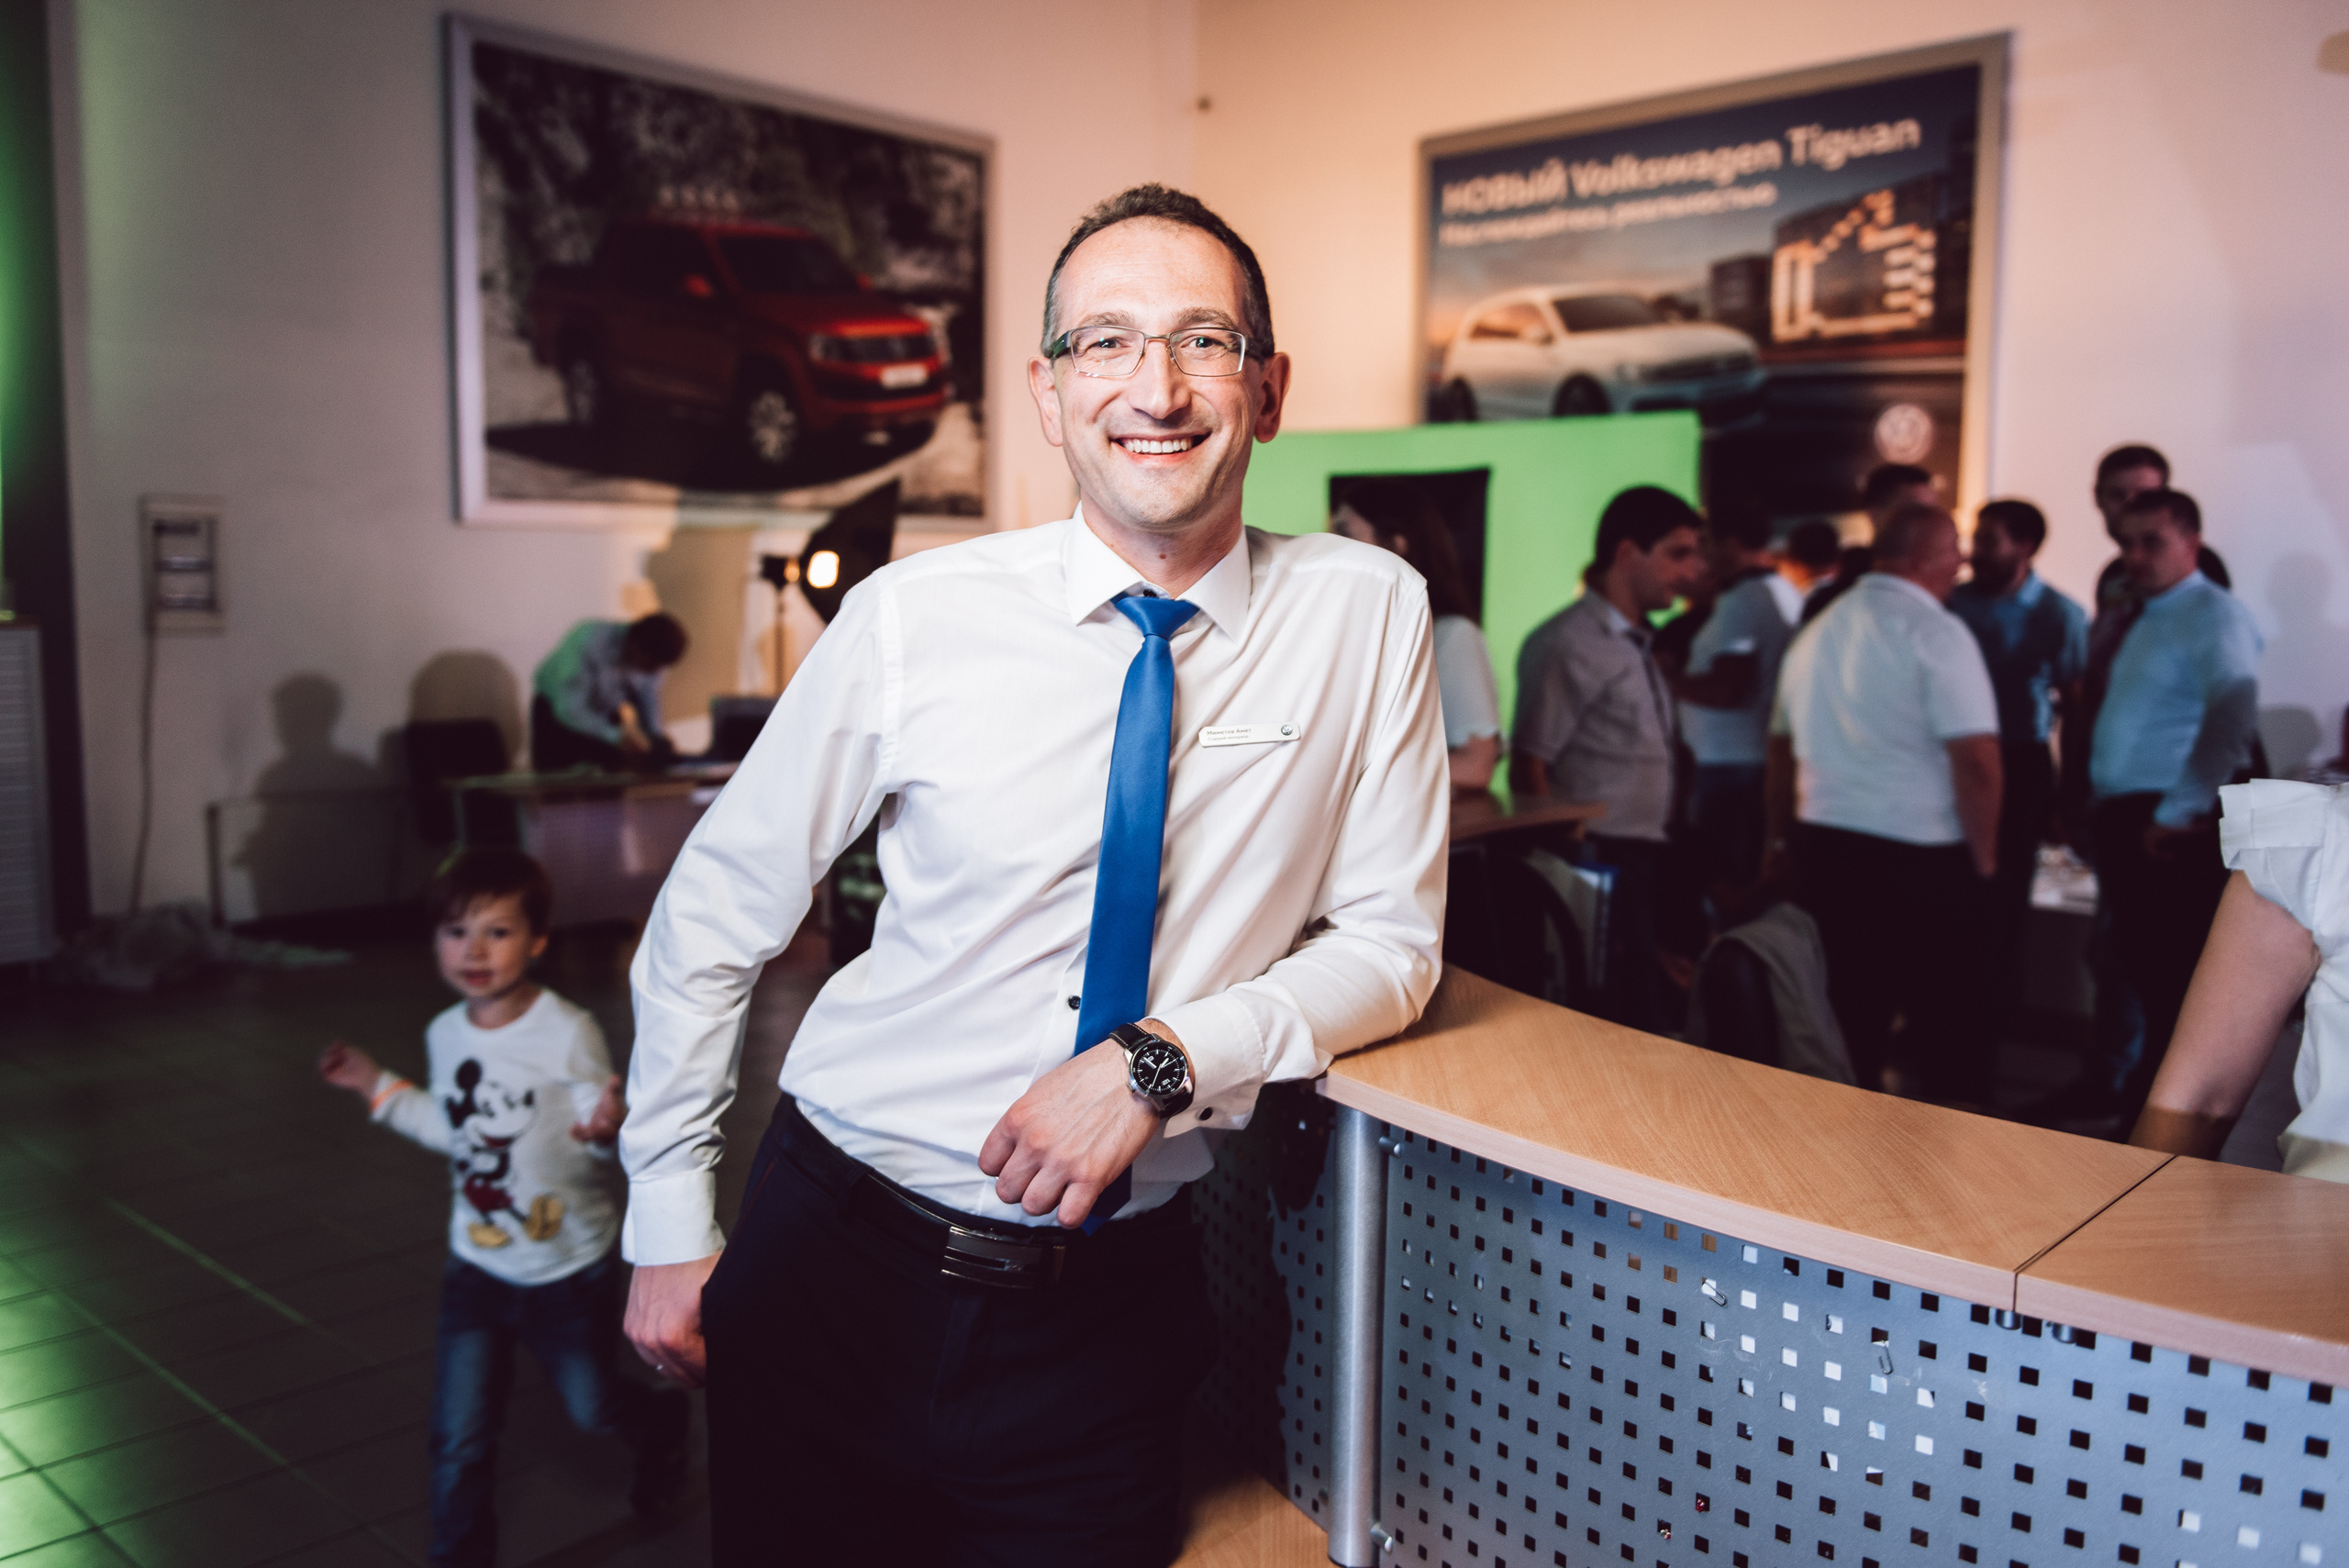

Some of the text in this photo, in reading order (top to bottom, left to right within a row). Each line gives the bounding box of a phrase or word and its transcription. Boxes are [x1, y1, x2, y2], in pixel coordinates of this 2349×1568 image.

[1444, 119, 1920, 214] НОВЫЙ Volkswagen Tiguan
